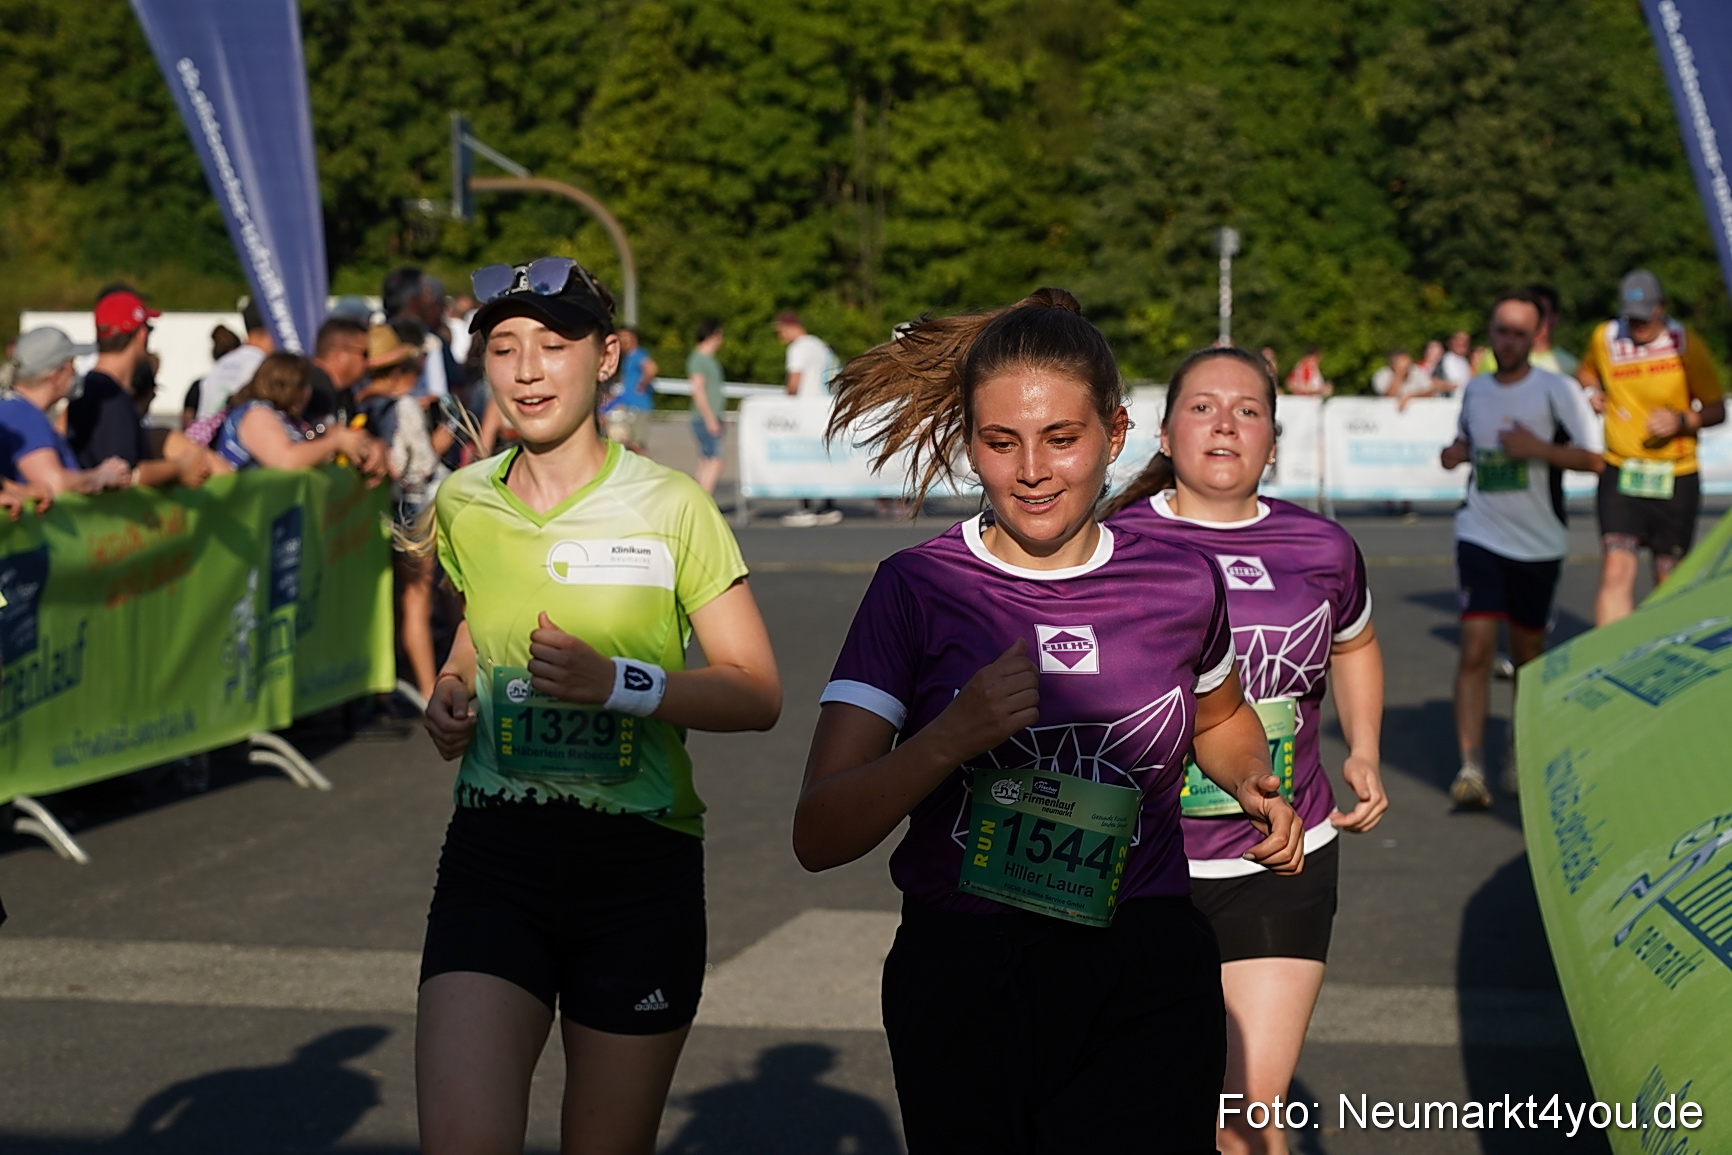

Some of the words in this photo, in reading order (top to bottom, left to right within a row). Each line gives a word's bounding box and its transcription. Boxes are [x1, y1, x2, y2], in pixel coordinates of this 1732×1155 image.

[611, 546, 652, 555] Klinikum
[1041, 641, 1094, 652] FUCHS
[501, 717, 513, 756] RUN
[517, 706, 617, 748] 1329
[619, 717, 635, 768] 2022
[1022, 792, 1076, 810] Firmenlauf
[1041, 806, 1073, 818] neumarkt
[973, 818, 997, 868] RUN
[1002, 811, 1117, 880] 1544
[1004, 861, 1043, 885] Hiller
[1046, 873, 1095, 898] Laura
[1107, 846, 1128, 908] 2022
